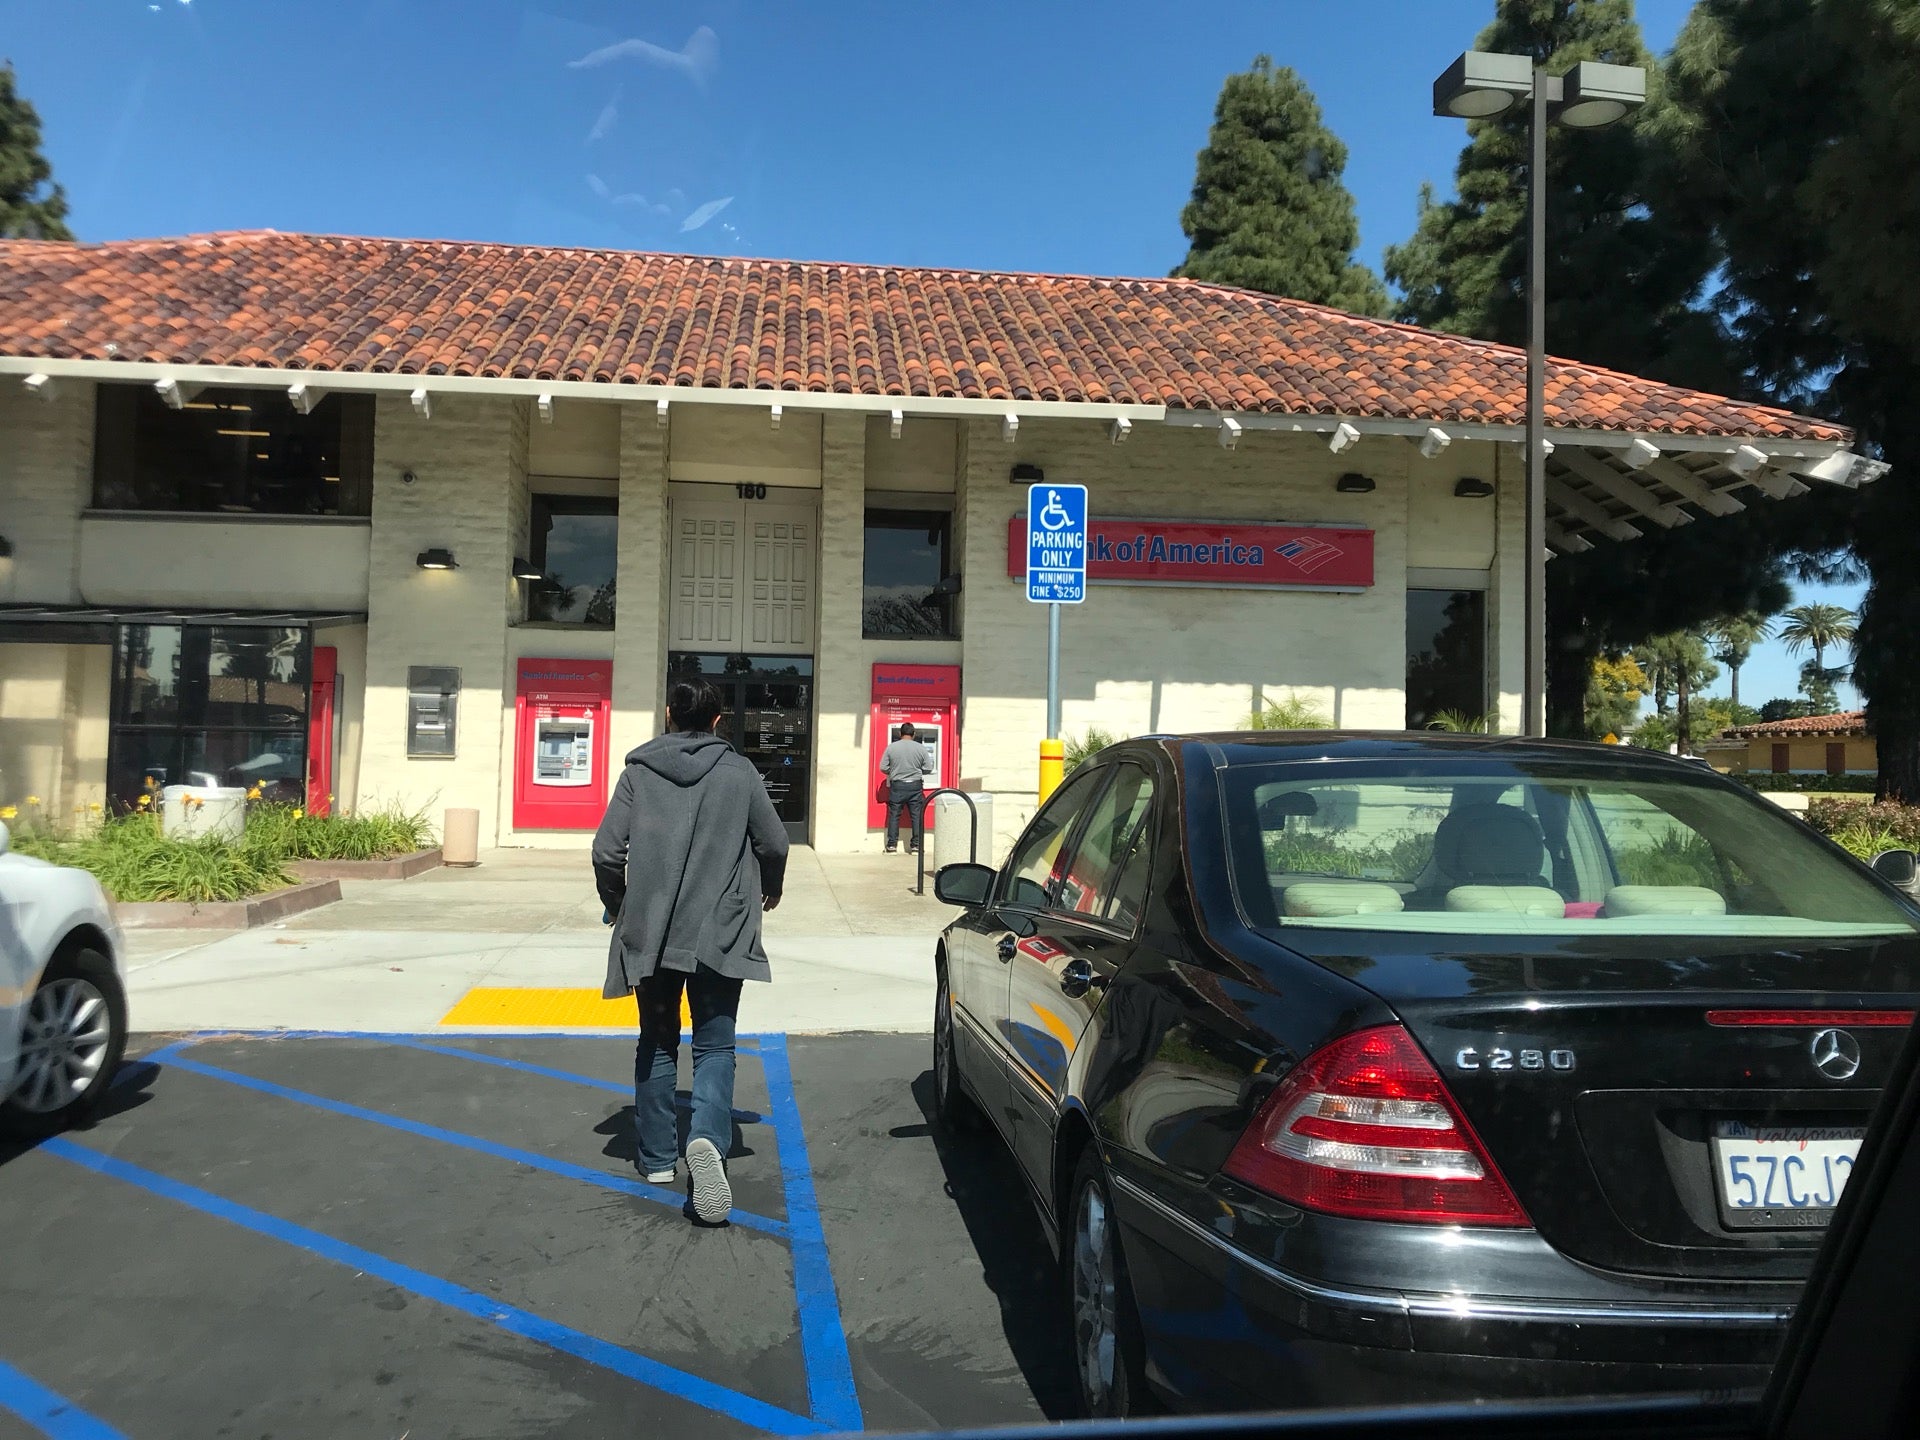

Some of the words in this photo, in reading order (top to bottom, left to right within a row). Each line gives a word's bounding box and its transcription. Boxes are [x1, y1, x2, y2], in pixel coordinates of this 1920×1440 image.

[1032, 531, 1083, 549] PARKING
[1041, 549, 1073, 567] ONLY
[1116, 535, 1146, 563] of
[1148, 536, 1264, 566] America
[1038, 572, 1075, 584] MINIMUM
[1032, 585, 1050, 597] FINE
[1056, 586, 1081, 599] $250
[1456, 1047, 1480, 1070] C
[1489, 1047, 1576, 1071] 280
